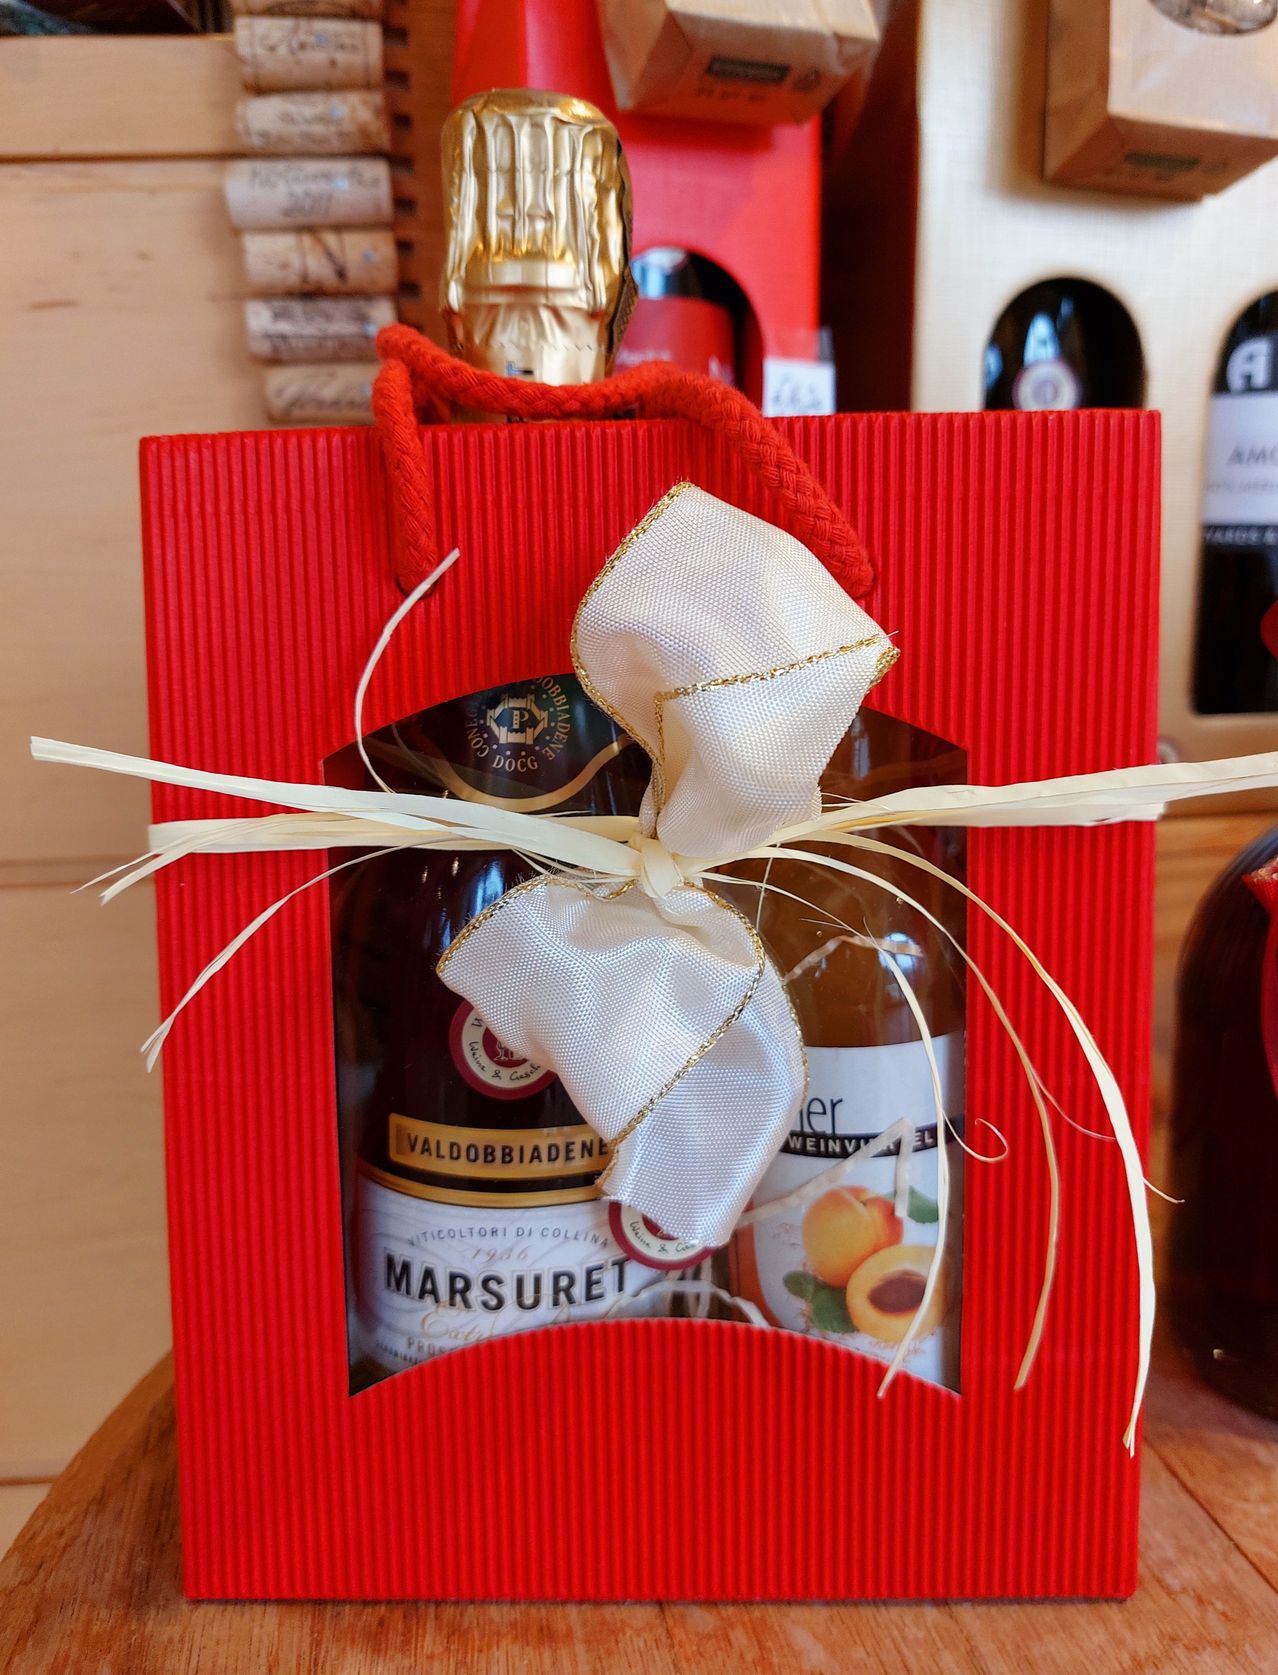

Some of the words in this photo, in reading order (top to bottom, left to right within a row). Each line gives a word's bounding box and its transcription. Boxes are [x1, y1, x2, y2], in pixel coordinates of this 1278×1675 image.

[492, 755, 538, 772] DOCG
[492, 1069, 503, 1080] &
[510, 1063, 542, 1081] Gesch
[407, 1133, 608, 1164] VALDOBBIADENE
[408, 1226, 507, 1248] VITICOLTORI
[516, 1226, 533, 1239] DI
[541, 1226, 609, 1249] COLLINA
[658, 1243, 669, 1254] &
[386, 1252, 632, 1312] MARSURET
